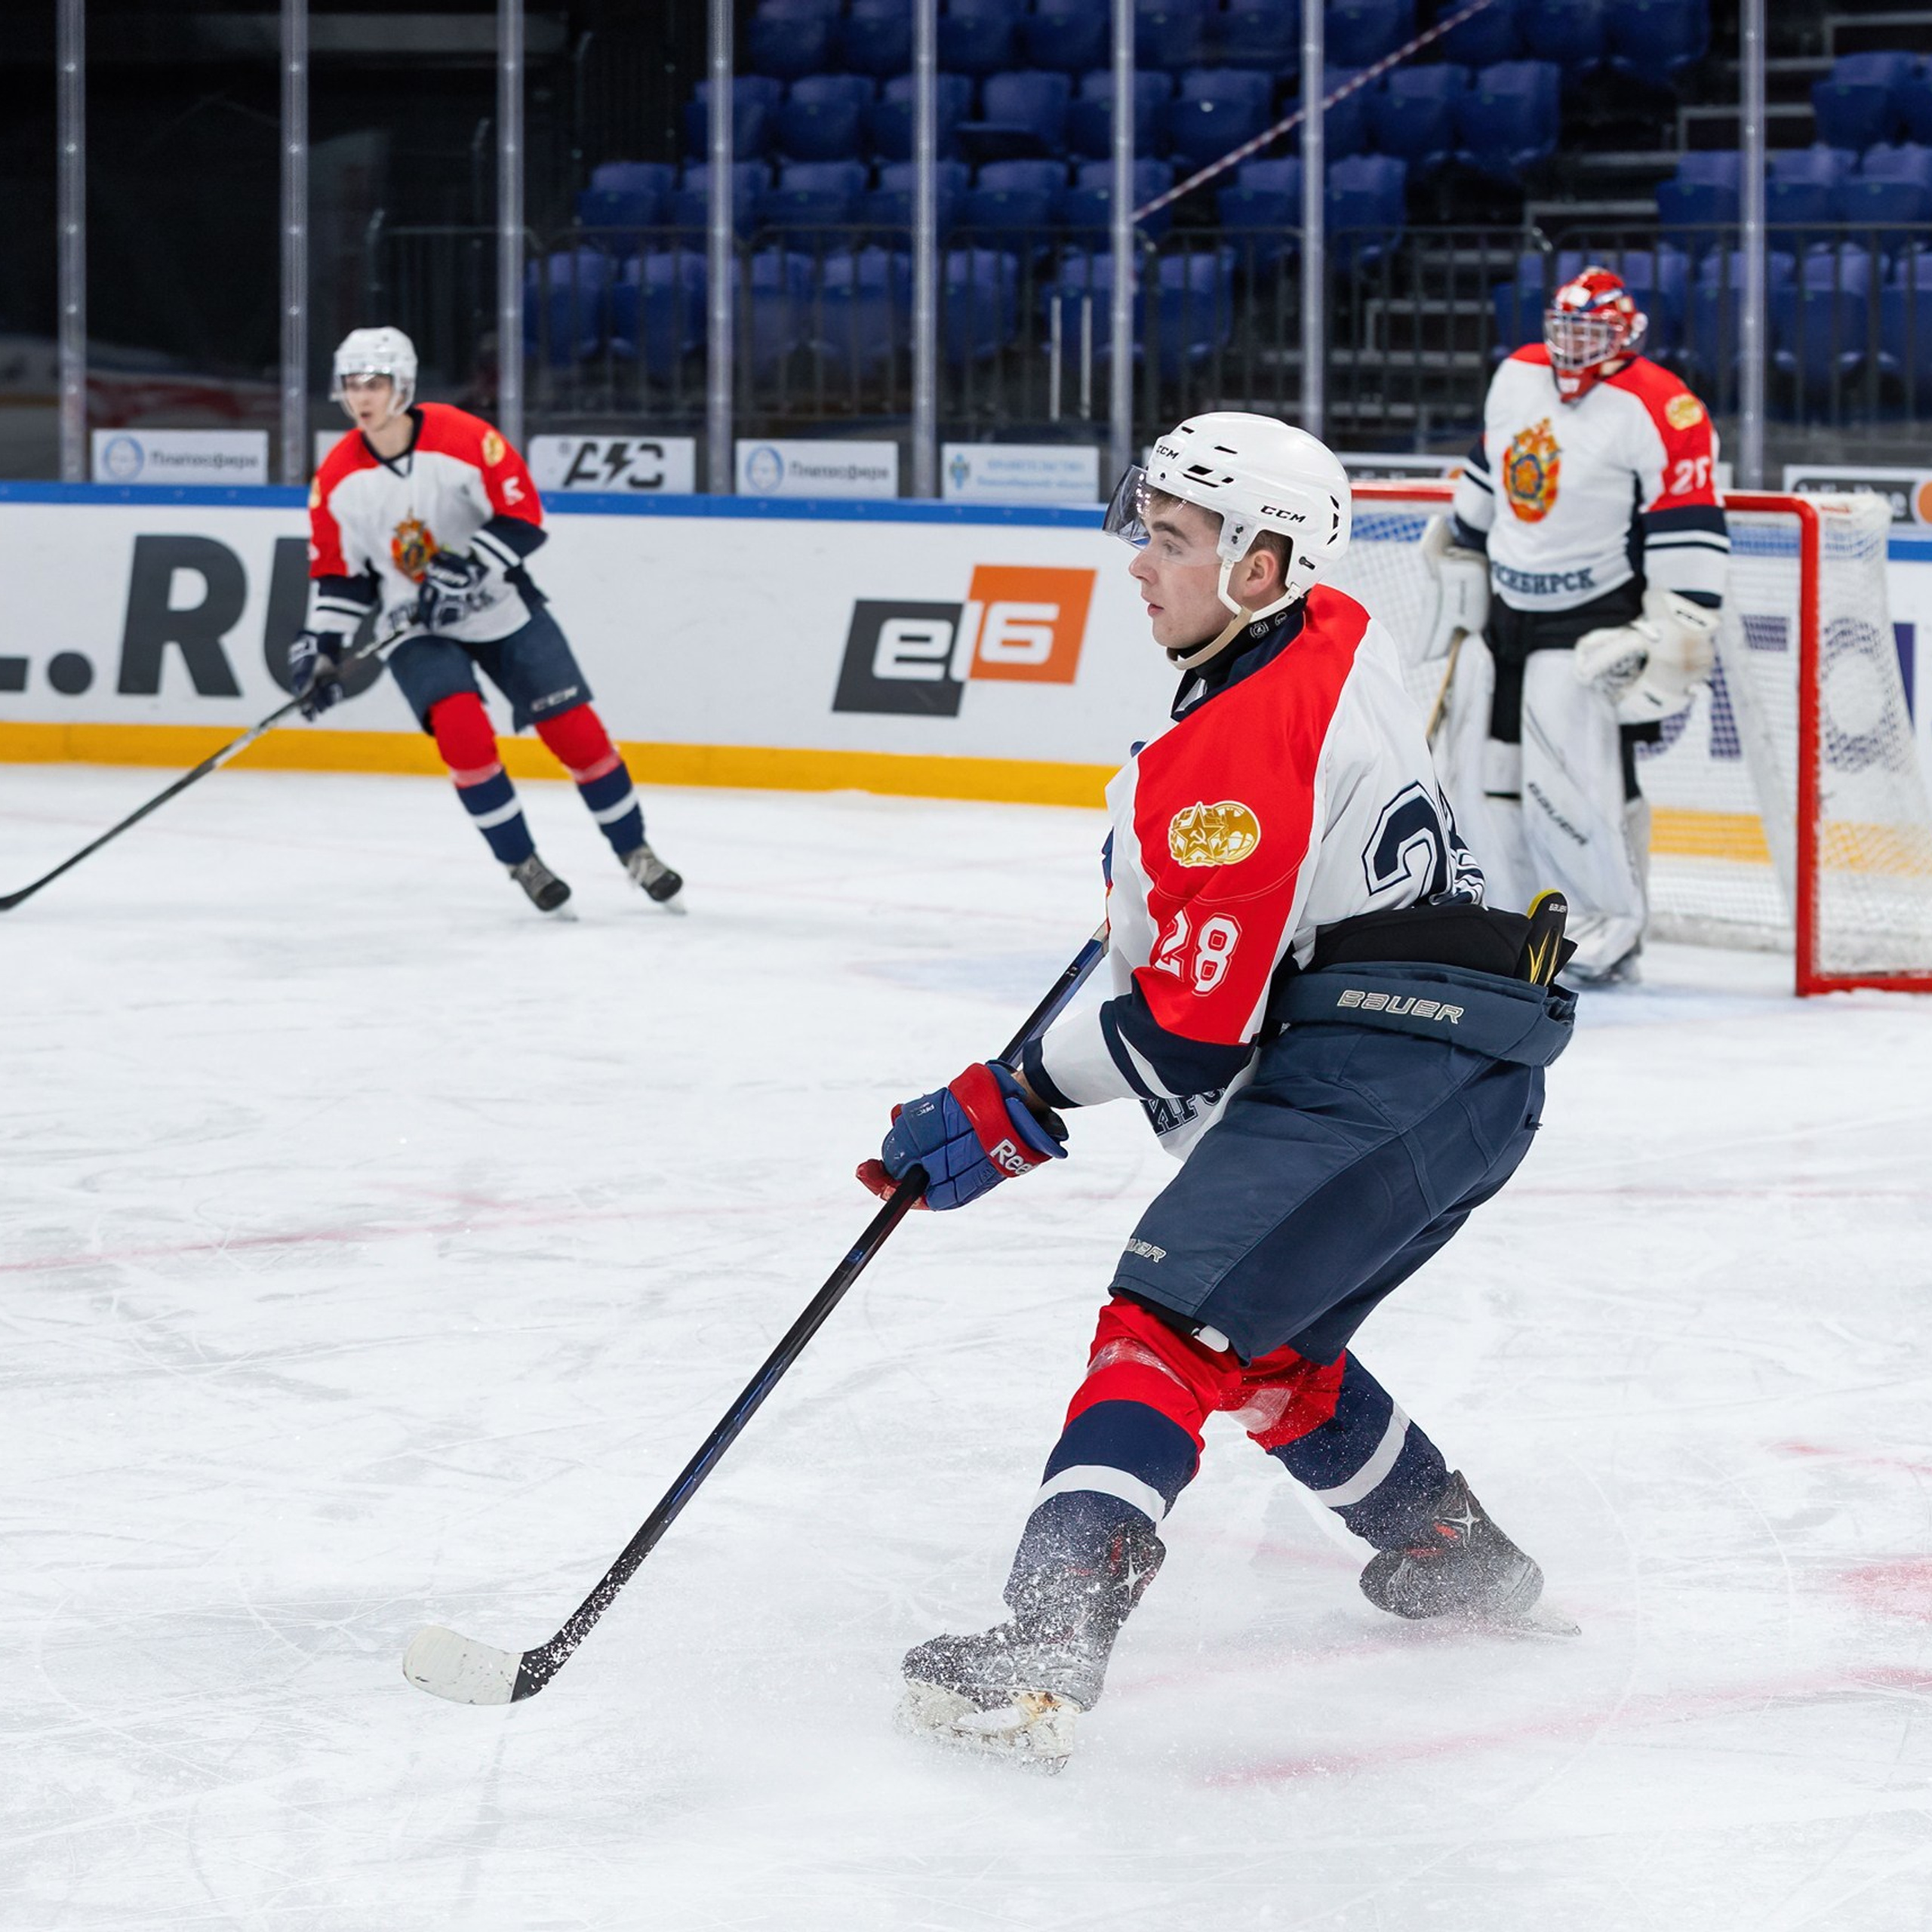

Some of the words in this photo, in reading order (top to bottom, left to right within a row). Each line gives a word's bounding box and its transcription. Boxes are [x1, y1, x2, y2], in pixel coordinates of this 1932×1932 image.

[1260, 505, 1306, 523] CCM
[0, 534, 387, 697] .RU
[1152, 906, 1243, 997] 28
[1337, 989, 1465, 1024] BAUER
